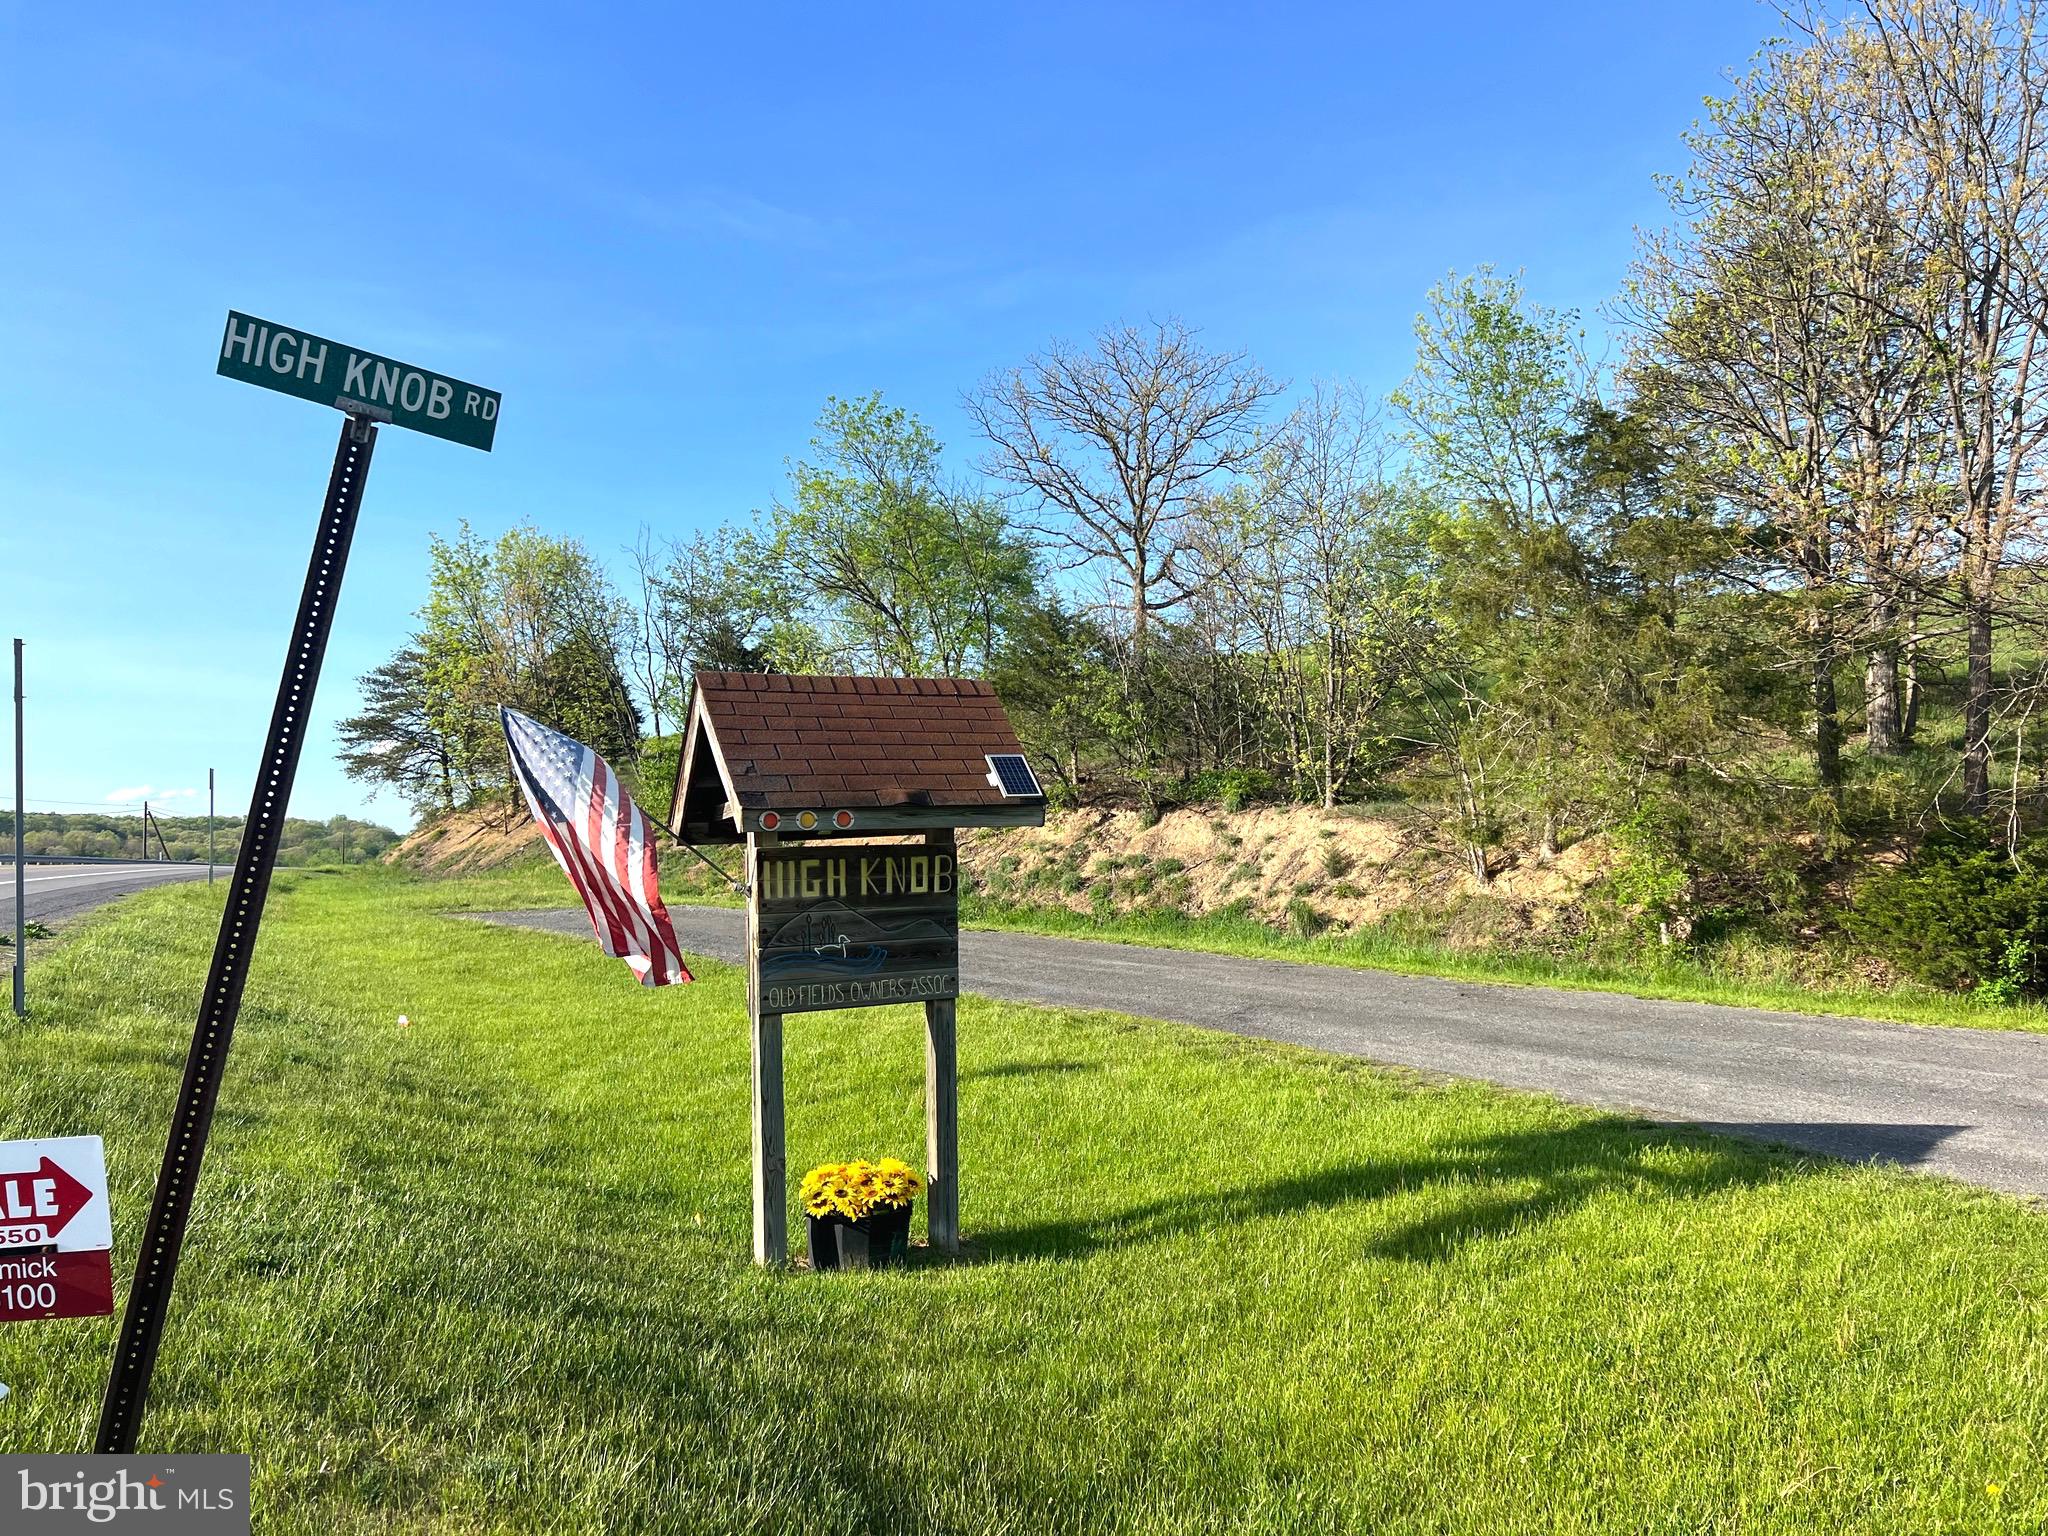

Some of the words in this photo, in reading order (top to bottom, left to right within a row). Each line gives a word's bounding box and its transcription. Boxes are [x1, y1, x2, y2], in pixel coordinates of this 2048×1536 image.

[223, 317, 328, 385] HIGH
[343, 353, 454, 420] KNOB
[463, 390, 498, 421] RD
[860, 854, 953, 896] KNOB
[769, 986, 796, 1008] OLD
[799, 983, 845, 1005] FIELDS
[850, 977, 906, 1001] OWNERS
[910, 974, 954, 997] ASSOC.
[0, 1178, 59, 1219] LE
[0, 1256, 58, 1280] mick
